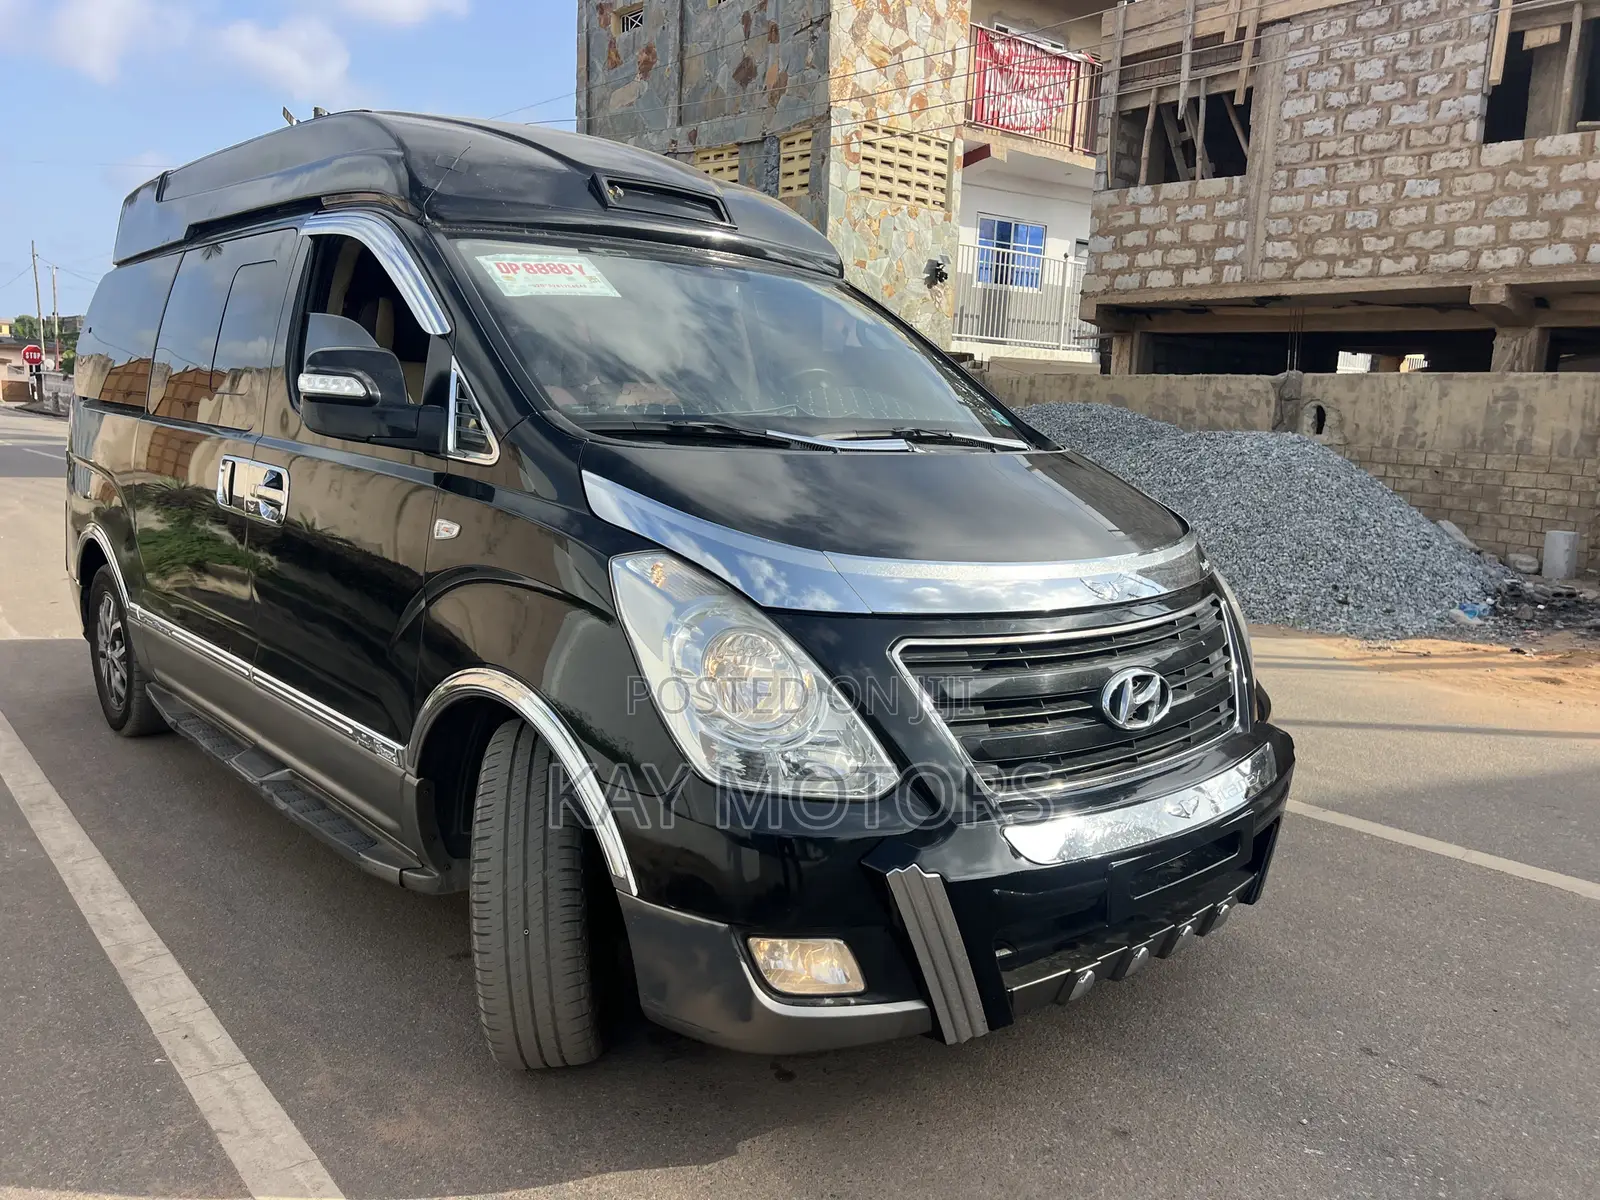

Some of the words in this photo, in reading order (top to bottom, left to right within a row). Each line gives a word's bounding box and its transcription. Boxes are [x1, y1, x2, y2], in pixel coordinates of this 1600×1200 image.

[495, 262, 520, 275] DP
[521, 262, 573, 275] 8888
[570, 263, 587, 276] Y
[25, 351, 41, 359] STOP
